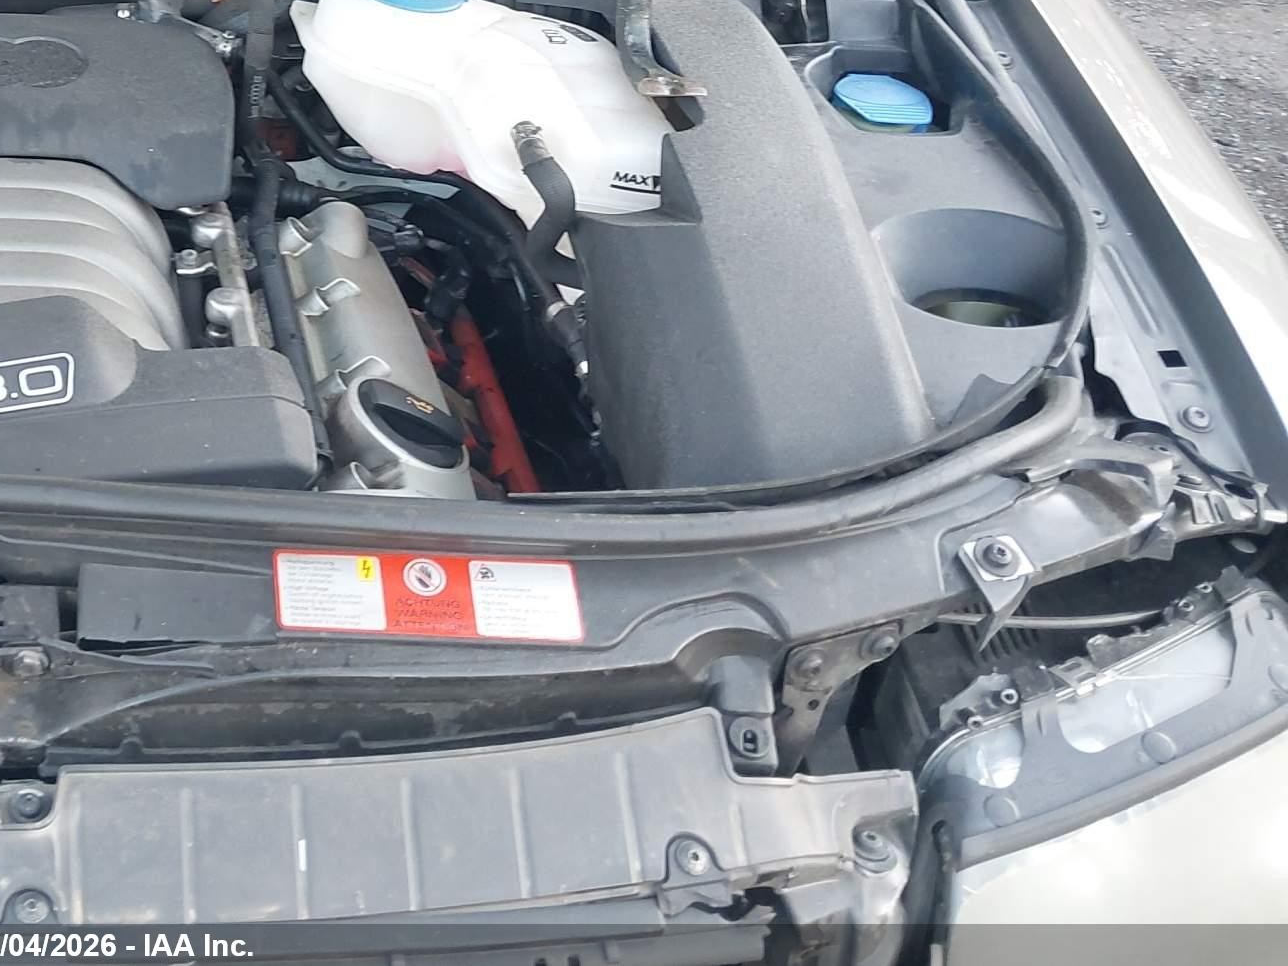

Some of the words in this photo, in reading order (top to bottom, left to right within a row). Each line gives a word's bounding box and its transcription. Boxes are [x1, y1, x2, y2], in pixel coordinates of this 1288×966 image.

[613, 171, 649, 186] MAX
[395, 597, 462, 610] ACHTUNG
[394, 608, 464, 620] WARNING
